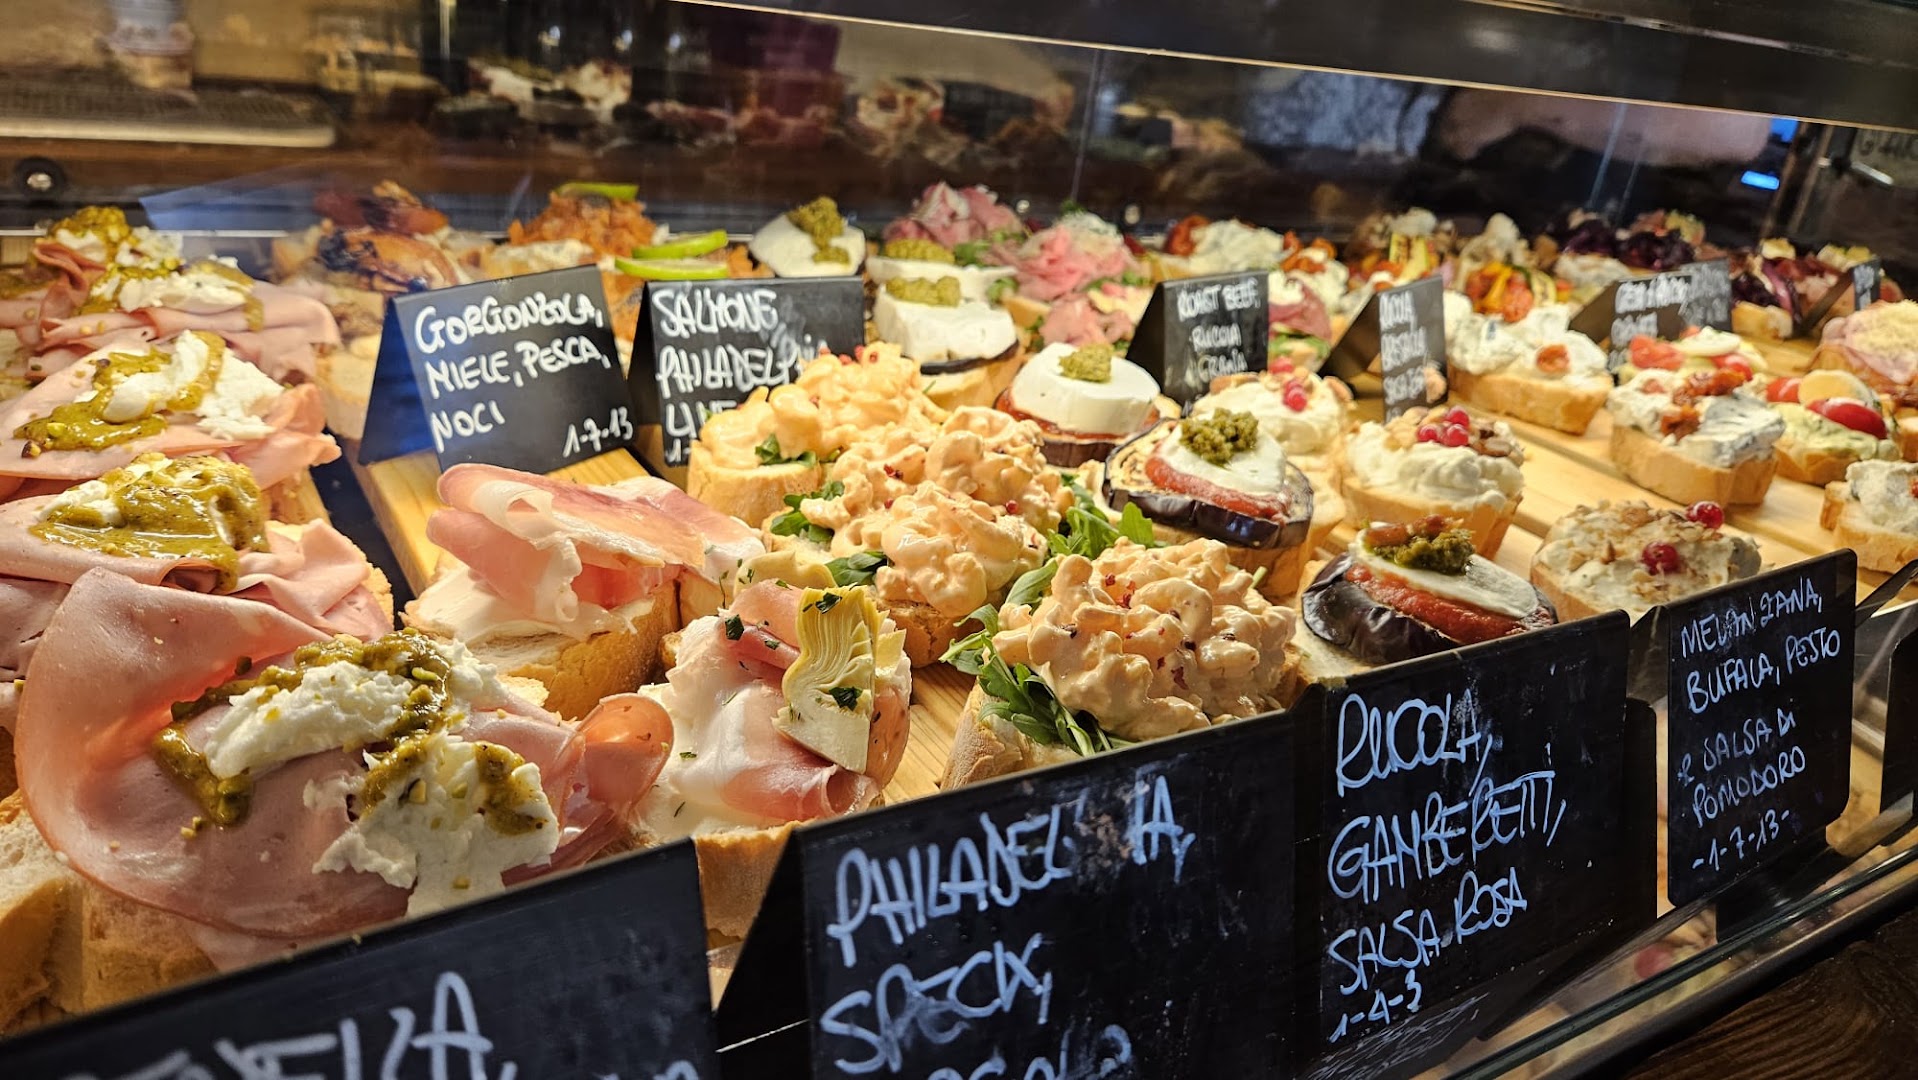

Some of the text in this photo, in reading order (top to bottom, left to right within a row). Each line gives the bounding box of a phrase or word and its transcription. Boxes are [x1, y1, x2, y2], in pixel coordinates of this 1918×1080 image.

[414, 292, 604, 354] GORGONZOLA,
[652, 288, 778, 338] SALMONE
[424, 336, 612, 399] MIELE, PESCA,
[430, 400, 506, 454] NOCI
[1686, 626, 1841, 714] BUFALA, PESTO
[1336, 688, 1493, 797] RUCOLA,
[1703, 717, 1772, 771] SALSA
[1693, 745, 1806, 828] POMODORO
[1327, 866, 1527, 995] SALSA ROSA
[820, 931, 1053, 1074] SPECK,
